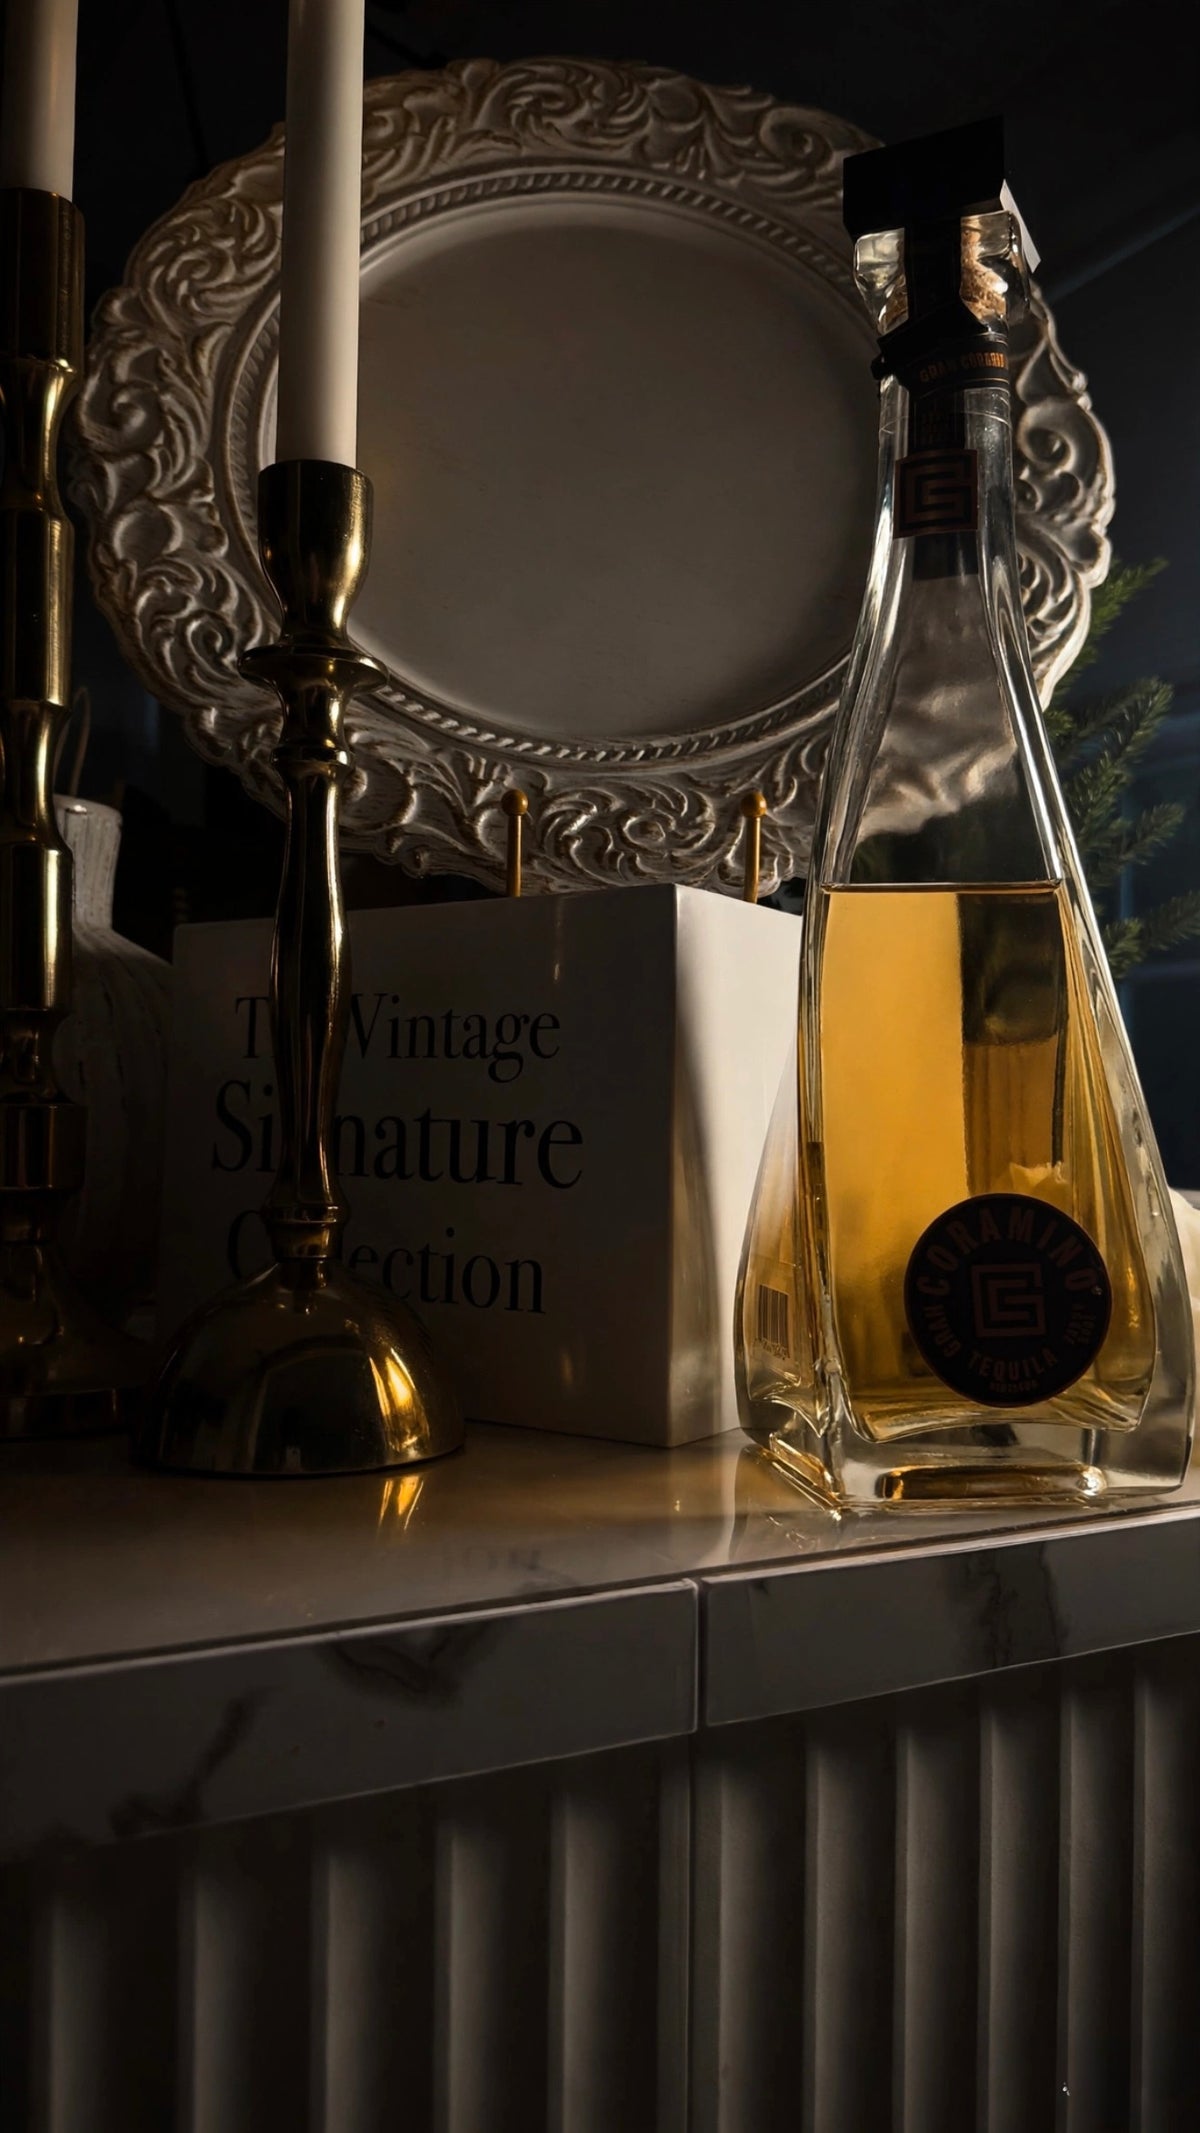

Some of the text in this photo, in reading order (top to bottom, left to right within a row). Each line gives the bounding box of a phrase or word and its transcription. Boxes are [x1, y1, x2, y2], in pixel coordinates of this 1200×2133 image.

[350, 992, 561, 1083] Vintage
[212, 1079, 583, 1189] Sinature
[227, 1209, 546, 1314] Cection
[915, 1205, 1100, 1297] CORAMINO
[922, 1302, 963, 1360] GRAN
[967, 1345, 1058, 1382] TEQUILA
